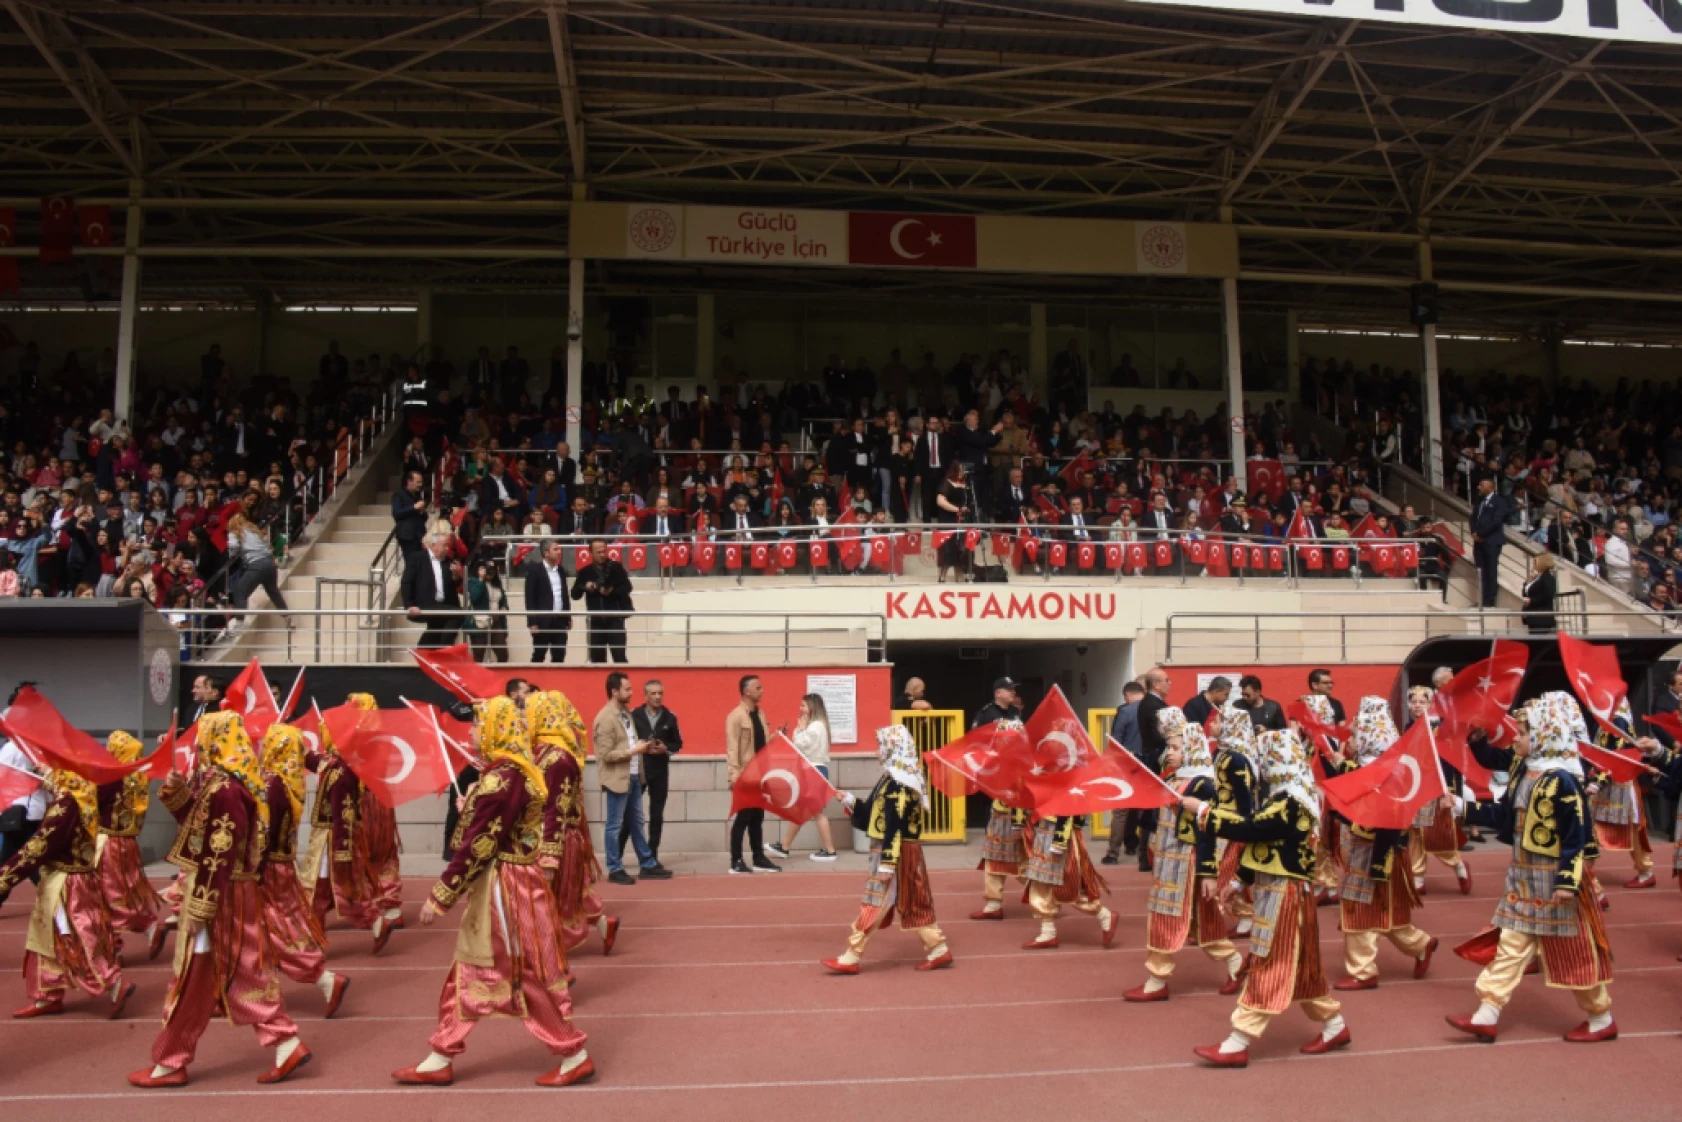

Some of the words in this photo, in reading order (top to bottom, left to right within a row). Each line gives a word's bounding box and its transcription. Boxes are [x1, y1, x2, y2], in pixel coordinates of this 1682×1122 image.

[738, 212, 797, 232] Güçlü
[707, 235, 785, 259] Türkiye
[793, 234, 828, 258] İçin
[885, 591, 1117, 620] KASTAMONU
